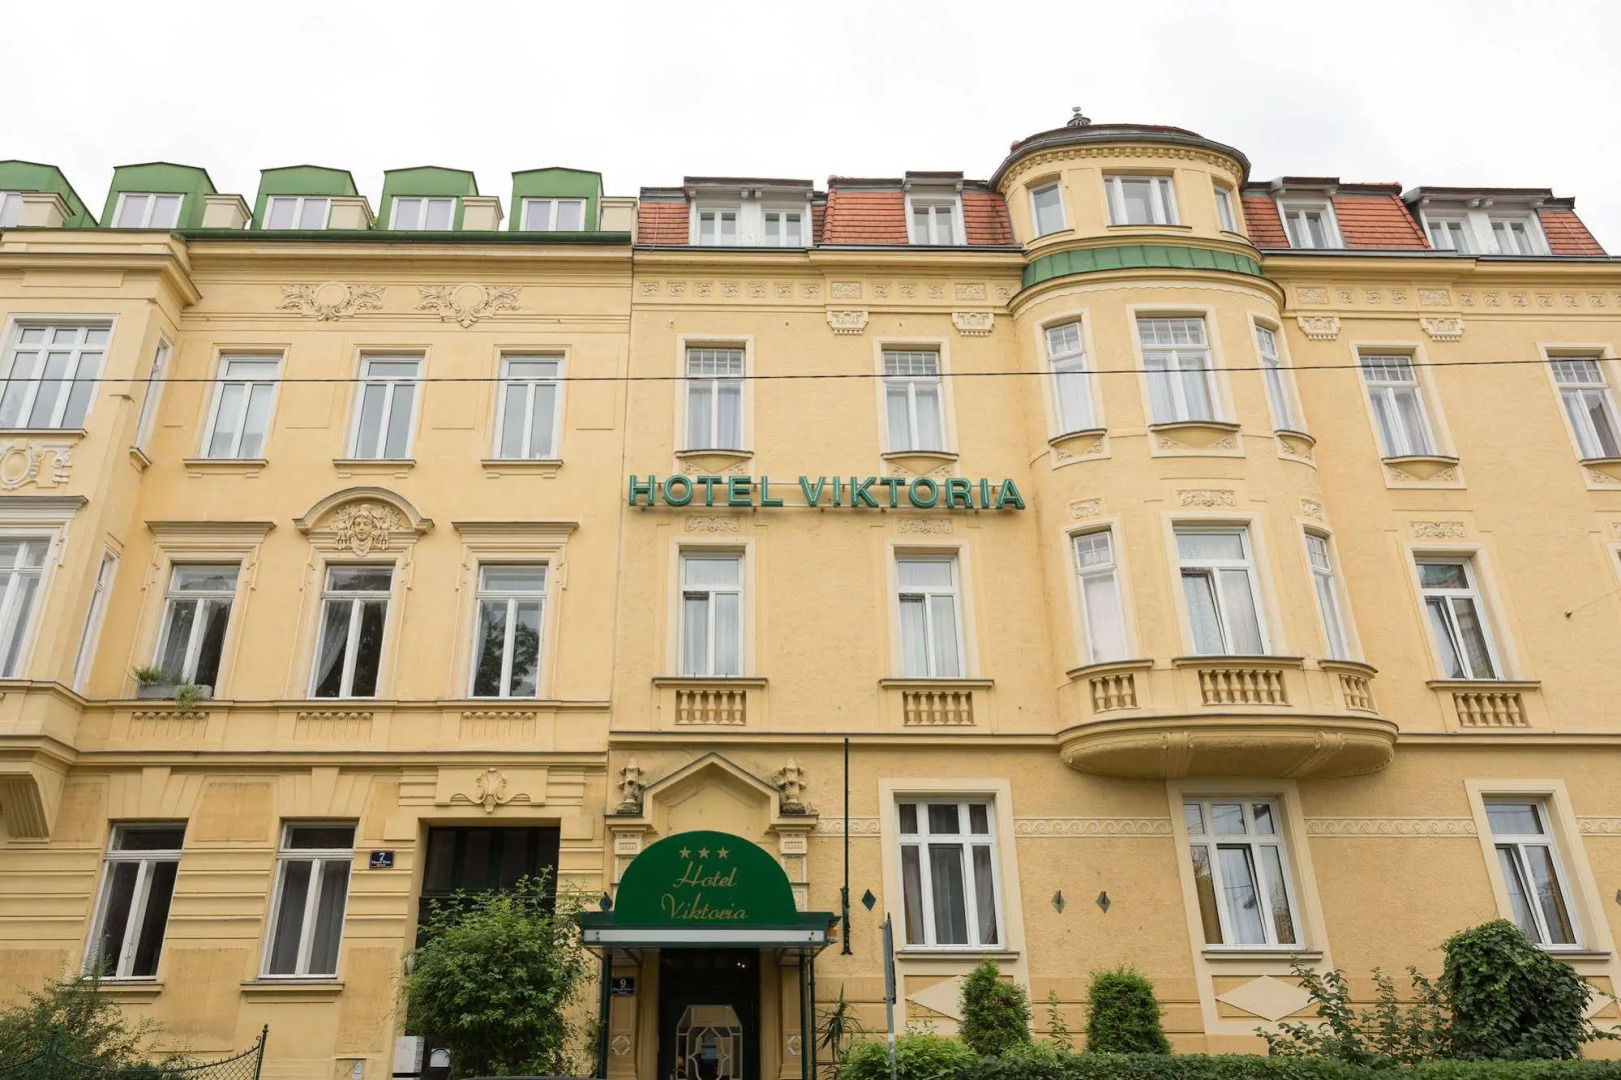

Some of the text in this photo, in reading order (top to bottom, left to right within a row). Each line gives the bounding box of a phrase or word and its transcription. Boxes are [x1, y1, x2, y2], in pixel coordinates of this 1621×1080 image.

[629, 474, 1025, 510] HOTEL VIKTORIA
[379, 852, 386, 861] 7
[672, 861, 738, 888] Hotel
[661, 892, 748, 919] Viktoria
[619, 978, 627, 988] 9
